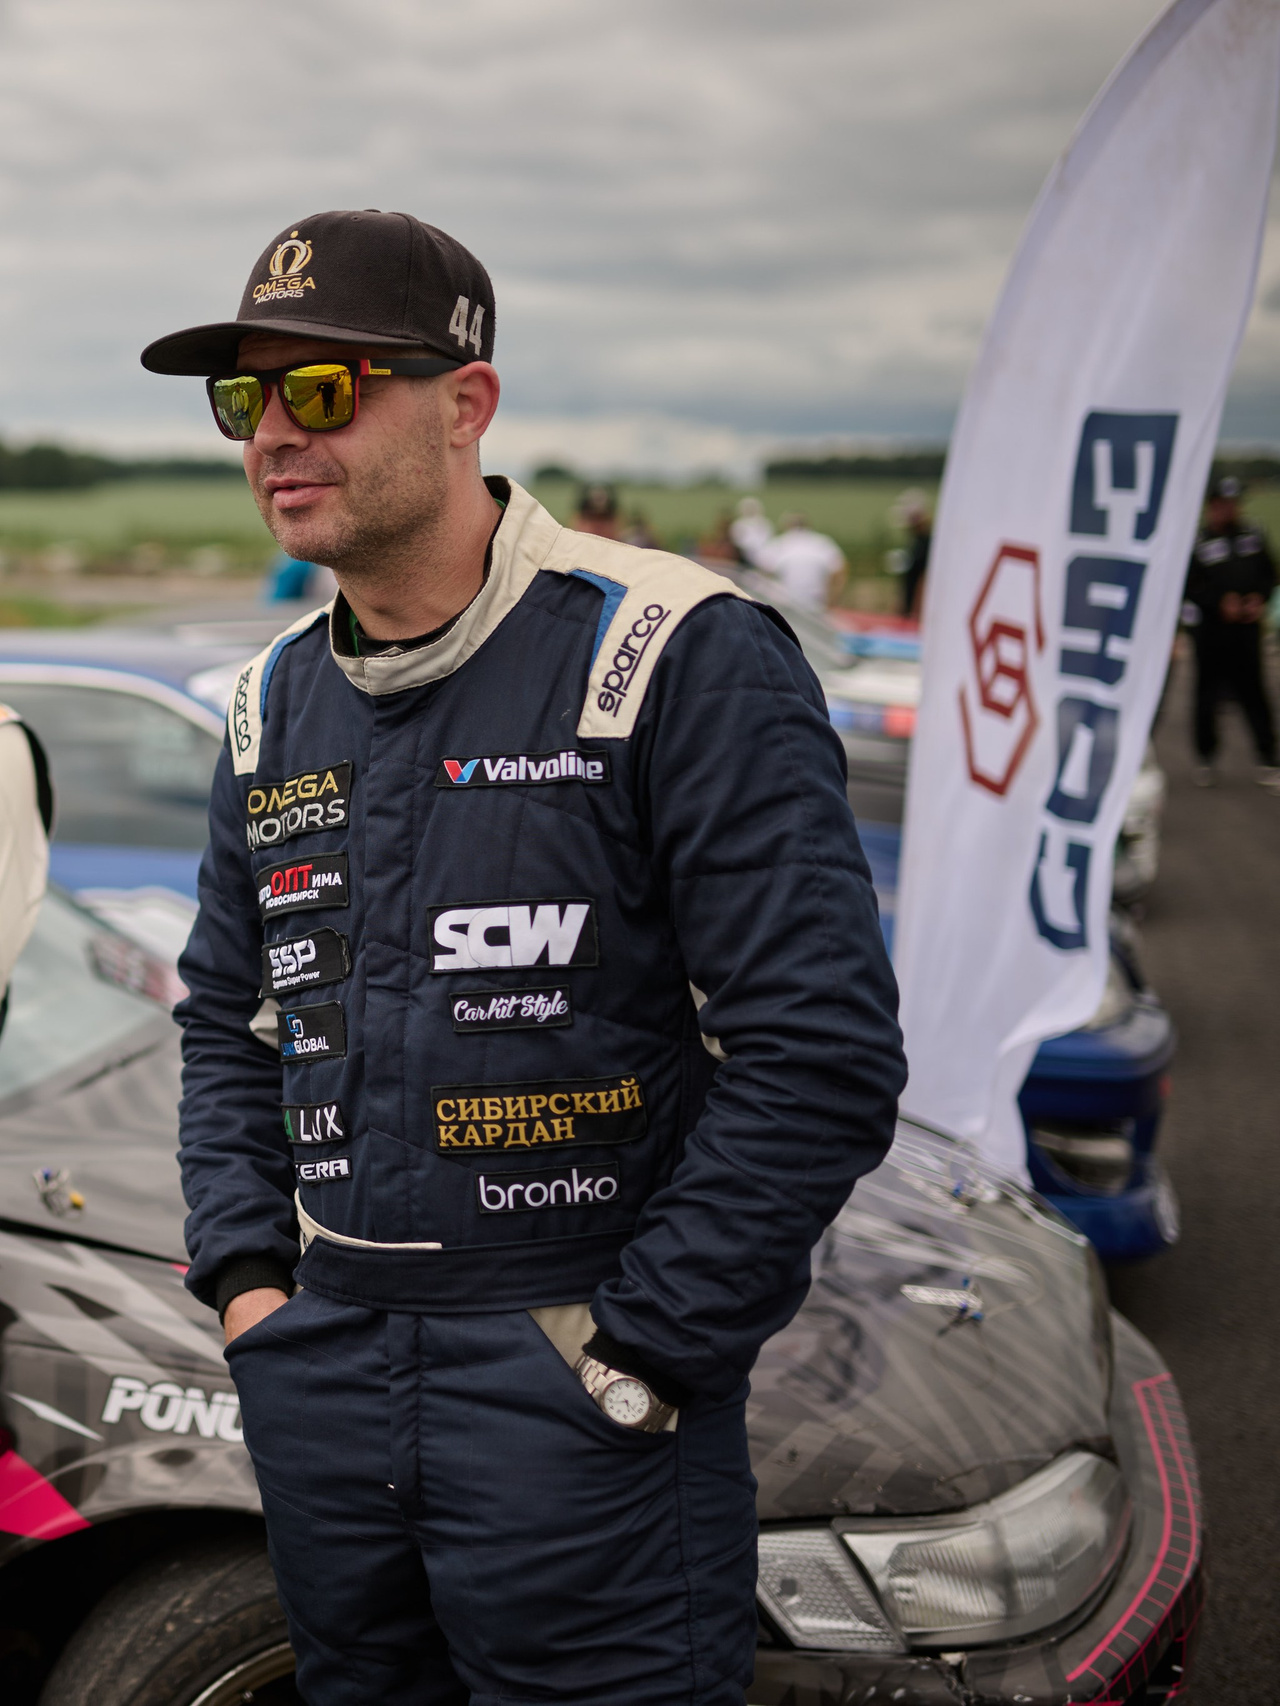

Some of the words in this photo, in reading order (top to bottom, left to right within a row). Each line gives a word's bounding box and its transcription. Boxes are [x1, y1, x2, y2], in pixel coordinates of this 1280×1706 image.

[252, 276, 317, 299] OMEGA
[255, 289, 305, 305] MOTORS
[448, 295, 486, 356] 44
[598, 604, 664, 712] sparco
[236, 666, 253, 753] sparco
[483, 751, 604, 781] Valvoline
[246, 799, 345, 847] MOTORS
[265, 889, 319, 910] НОВОСИБИРСК
[433, 904, 590, 970] SCW
[269, 939, 316, 978] SSP
[520, 990, 568, 1022] Style
[436, 1077, 643, 1122] СИБИРСКИЙ
[438, 1117, 576, 1148] КАРДАН
[295, 1159, 349, 1180] ERA
[478, 1168, 617, 1210] bronko
